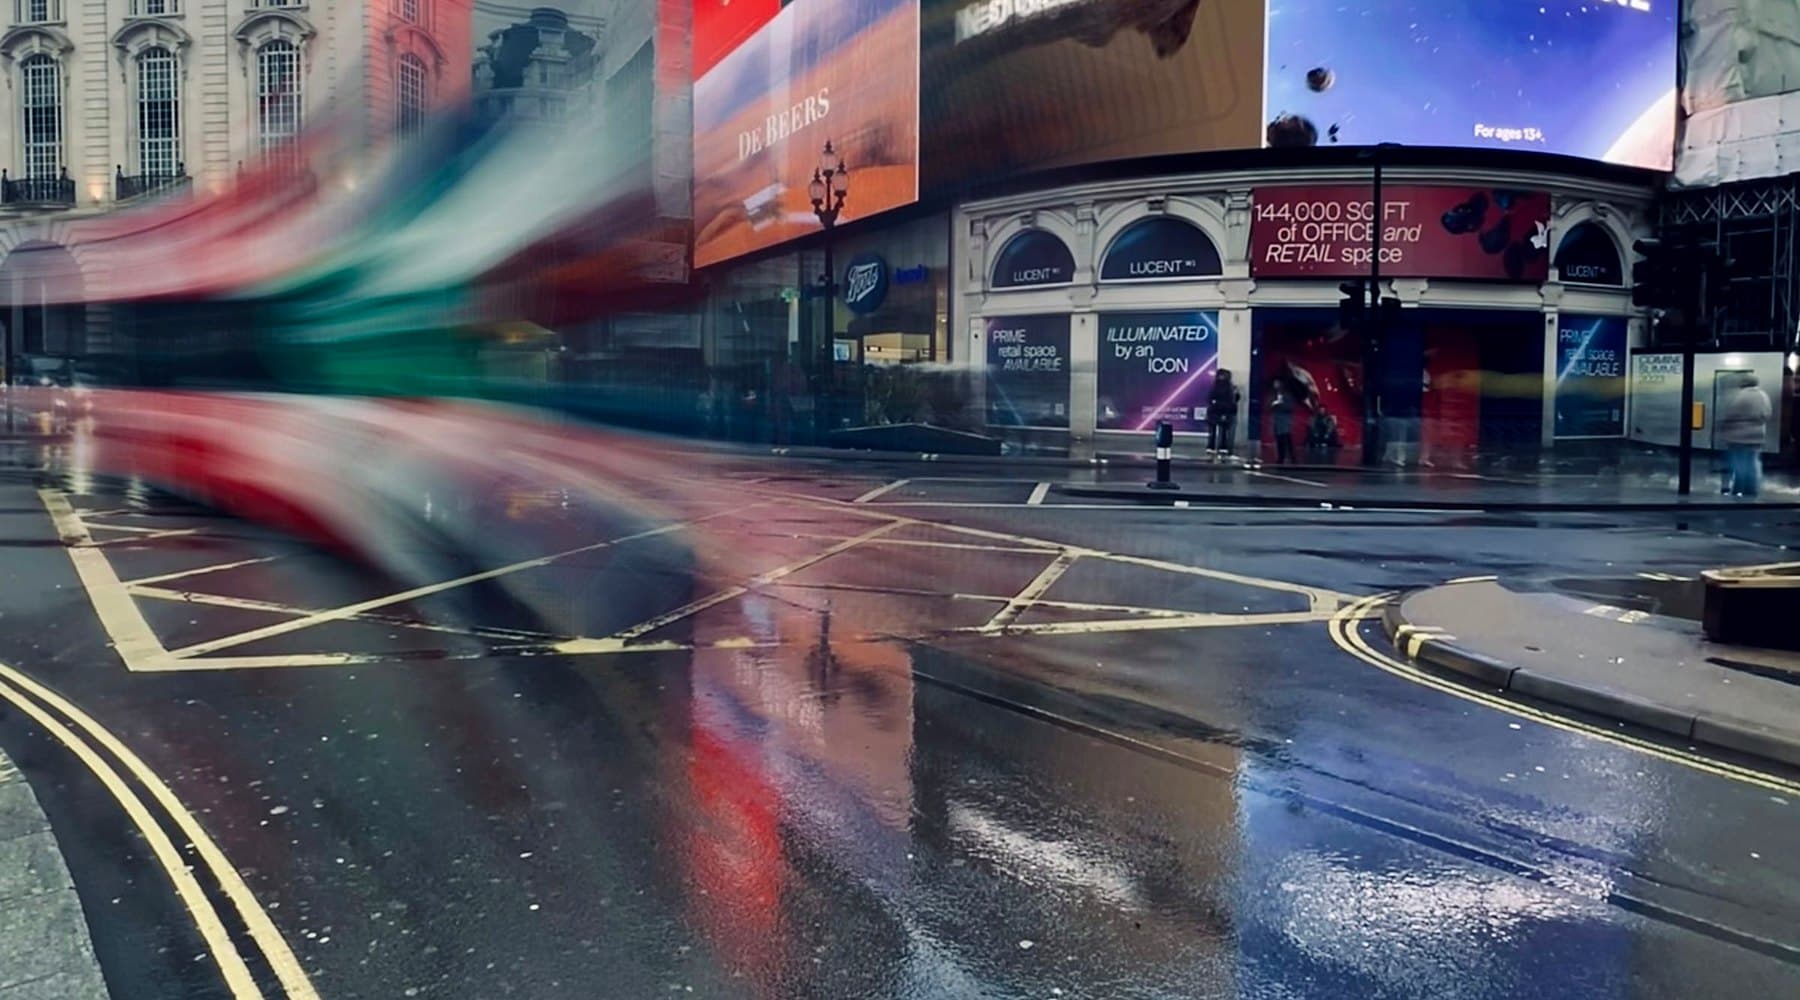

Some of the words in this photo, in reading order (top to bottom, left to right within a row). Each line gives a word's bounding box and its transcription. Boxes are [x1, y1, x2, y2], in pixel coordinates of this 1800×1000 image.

[738, 127, 762, 161] DE
[765, 87, 830, 149] BEERS
[1474, 123, 1495, 138] For
[1495, 128, 1522, 142] ages
[1255, 201, 1341, 223] 144,000
[1383, 202, 1410, 221] FT
[1277, 224, 1298, 242] of
[1302, 222, 1374, 242] OFFICE
[1383, 224, 1422, 242] and
[1265, 244, 1336, 263] RETAIL
[1341, 247, 1403, 266] space
[1013, 268, 1050, 282] LUCENT
[1130, 260, 1182, 275] LUCENT
[1566, 264, 1599, 278] LUCENT
[992, 329, 1026, 344] PRIME
[1106, 325, 1209, 342] ILLUMINATED
[1560, 328, 1591, 343] PRIME
[998, 344, 1021, 358] retail
[1023, 345, 1057, 359] space
[1115, 344, 1132, 360] by
[1135, 346, 1154, 357] an
[1588, 350, 1615, 361] space
[1003, 357, 1062, 372] AVAILABLE
[1148, 358, 1188, 373] ICON
[1570, 361, 1619, 377] AVAILABLE
